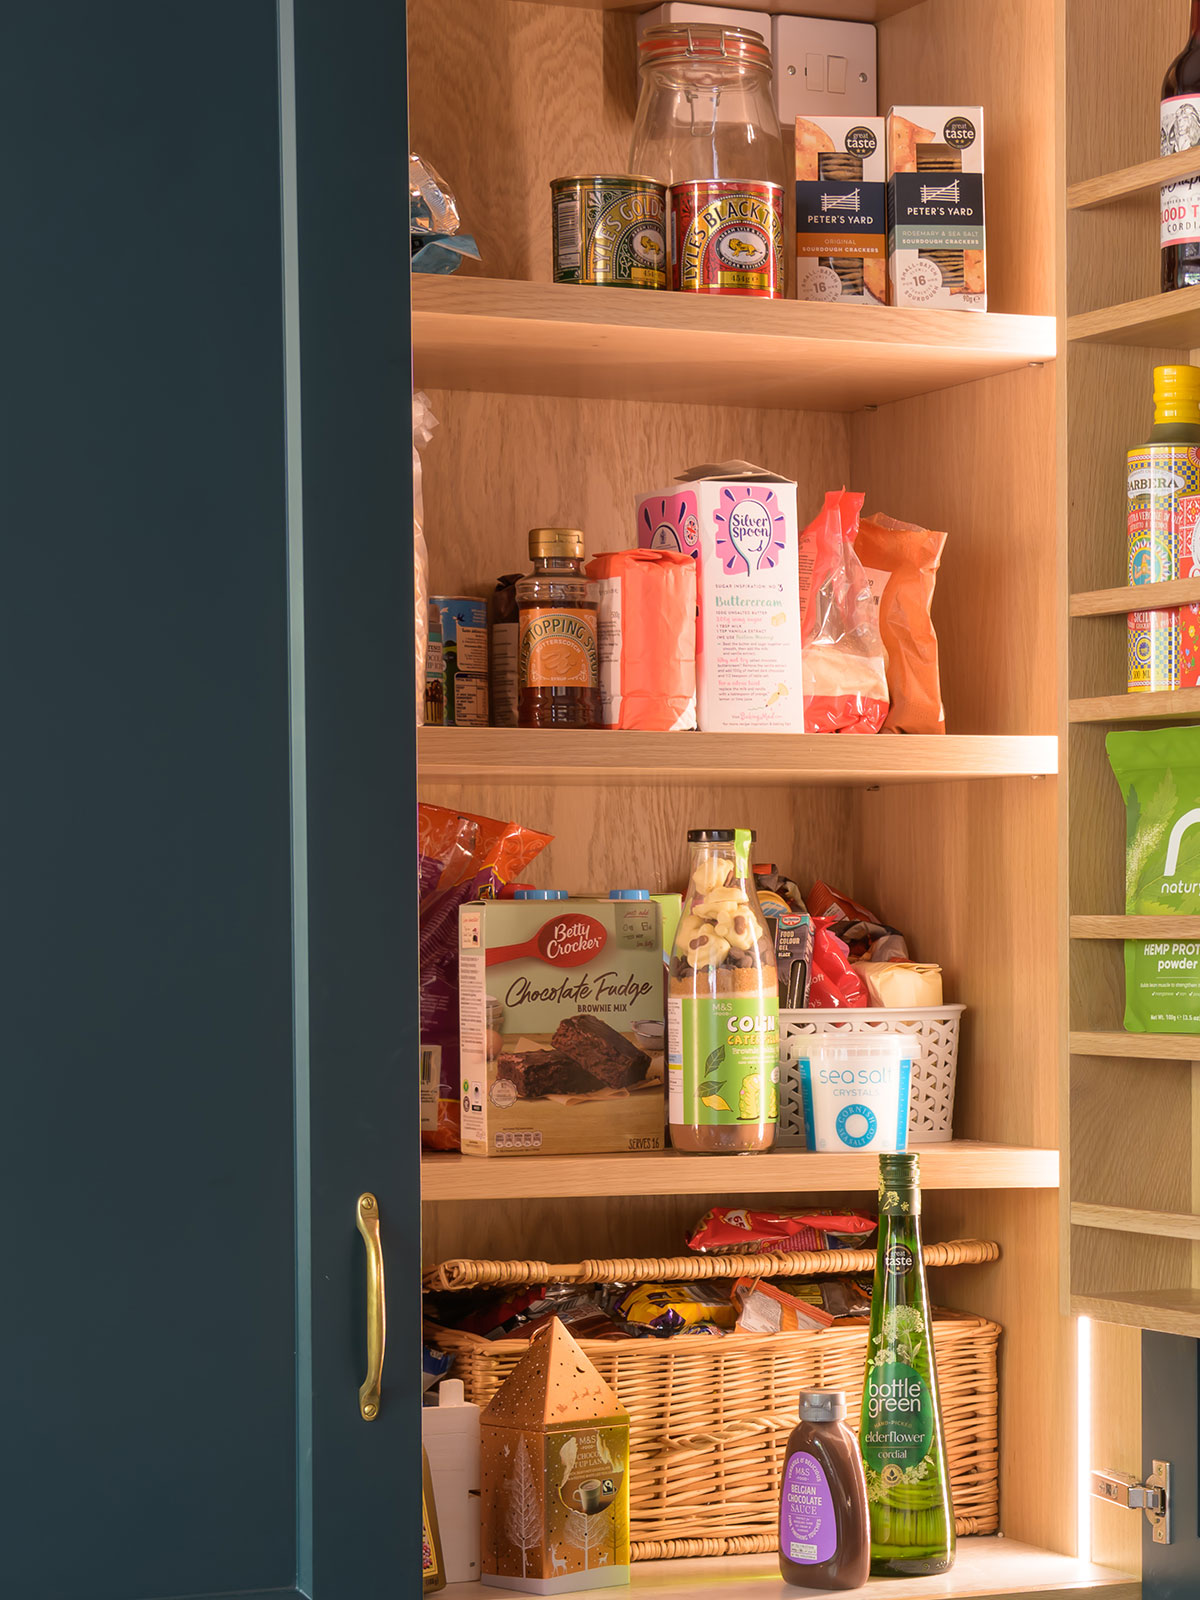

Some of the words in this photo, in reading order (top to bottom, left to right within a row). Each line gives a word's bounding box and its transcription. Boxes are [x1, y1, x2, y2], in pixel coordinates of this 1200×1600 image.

[945, 129, 974, 140] taste
[846, 137, 876, 150] taste
[907, 207, 945, 216] PETER'S
[948, 207, 974, 216] YARD
[1161, 206, 1186, 223] LOOD
[807, 215, 846, 224] PETER'S
[848, 216, 874, 225] YARD
[685, 228, 707, 281] LYLE'S
[703, 201, 761, 229] BLACK
[912, 275, 926, 286] 16
[813, 282, 826, 294] 16
[732, 513, 769, 527] Silver
[715, 595, 782, 608] Buttercream
[528, 618, 586, 641] TOPPING
[536, 638, 582, 654] BUTTERSCOTCH
[554, 922, 590, 942] Betty
[546, 937, 600, 959] Crocker
[1144, 943, 1170, 956] HEMP
[1158, 957, 1198, 972] powder
[505, 972, 592, 1008] Chocolate
[593, 972, 652, 1006] Fudge
[577, 1004, 612, 1012] BROWNIE
[613, 1004, 628, 1012] MIX
[712, 1002, 733, 1012] M&S
[820, 1070, 855, 1084] sea
[858, 1067, 892, 1084] salt
[832, 1088, 880, 1096] CRYSTALS
[839, 1105, 876, 1124] CORNISH
[839, 1128, 850, 1142] SEA
[849, 1137, 866, 1146] SALT
[628, 1138, 652, 1150] SERVES
[652, 1138, 660, 1149] 16
[885, 1256, 912, 1266] taste
[868, 1378, 921, 1398] bottle
[868, 1397, 921, 1418] green
[874, 1421, 912, 1429] HAND-PICKED
[580, 1435, 596, 1444] M&S
[865, 1430, 926, 1444] elderflower
[877, 1450, 908, 1459] cordial
[795, 1467, 810, 1477] M&S
[790, 1484, 816, 1496] BELGIAN
[787, 1493, 822, 1506] CHOCOLATE
[790, 1504, 817, 1515] SAUCE
